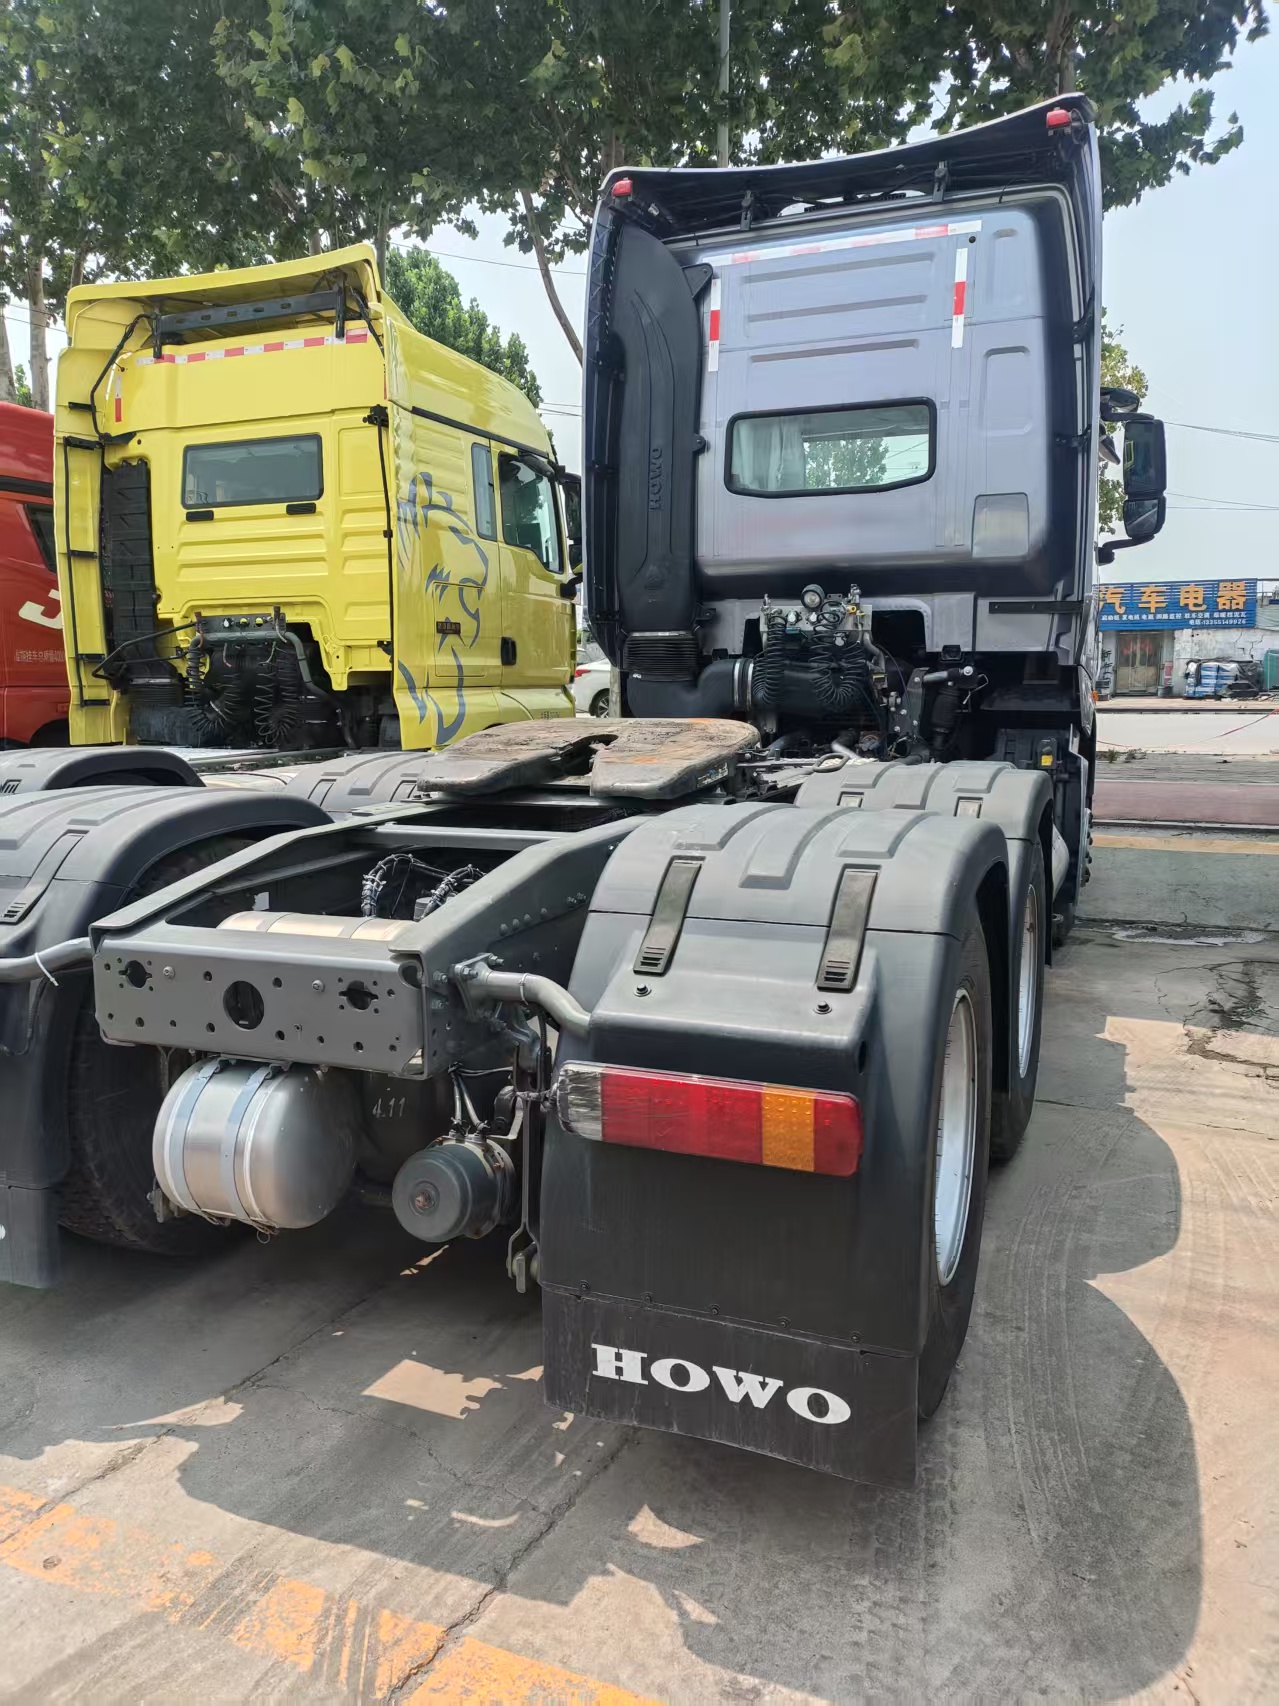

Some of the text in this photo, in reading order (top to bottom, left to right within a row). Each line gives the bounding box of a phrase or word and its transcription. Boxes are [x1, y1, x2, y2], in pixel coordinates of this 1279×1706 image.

[649, 448, 663, 511] HOWO
[1098, 581, 1247, 613] 汽车电器
[591, 1343, 851, 1424] HOWO
